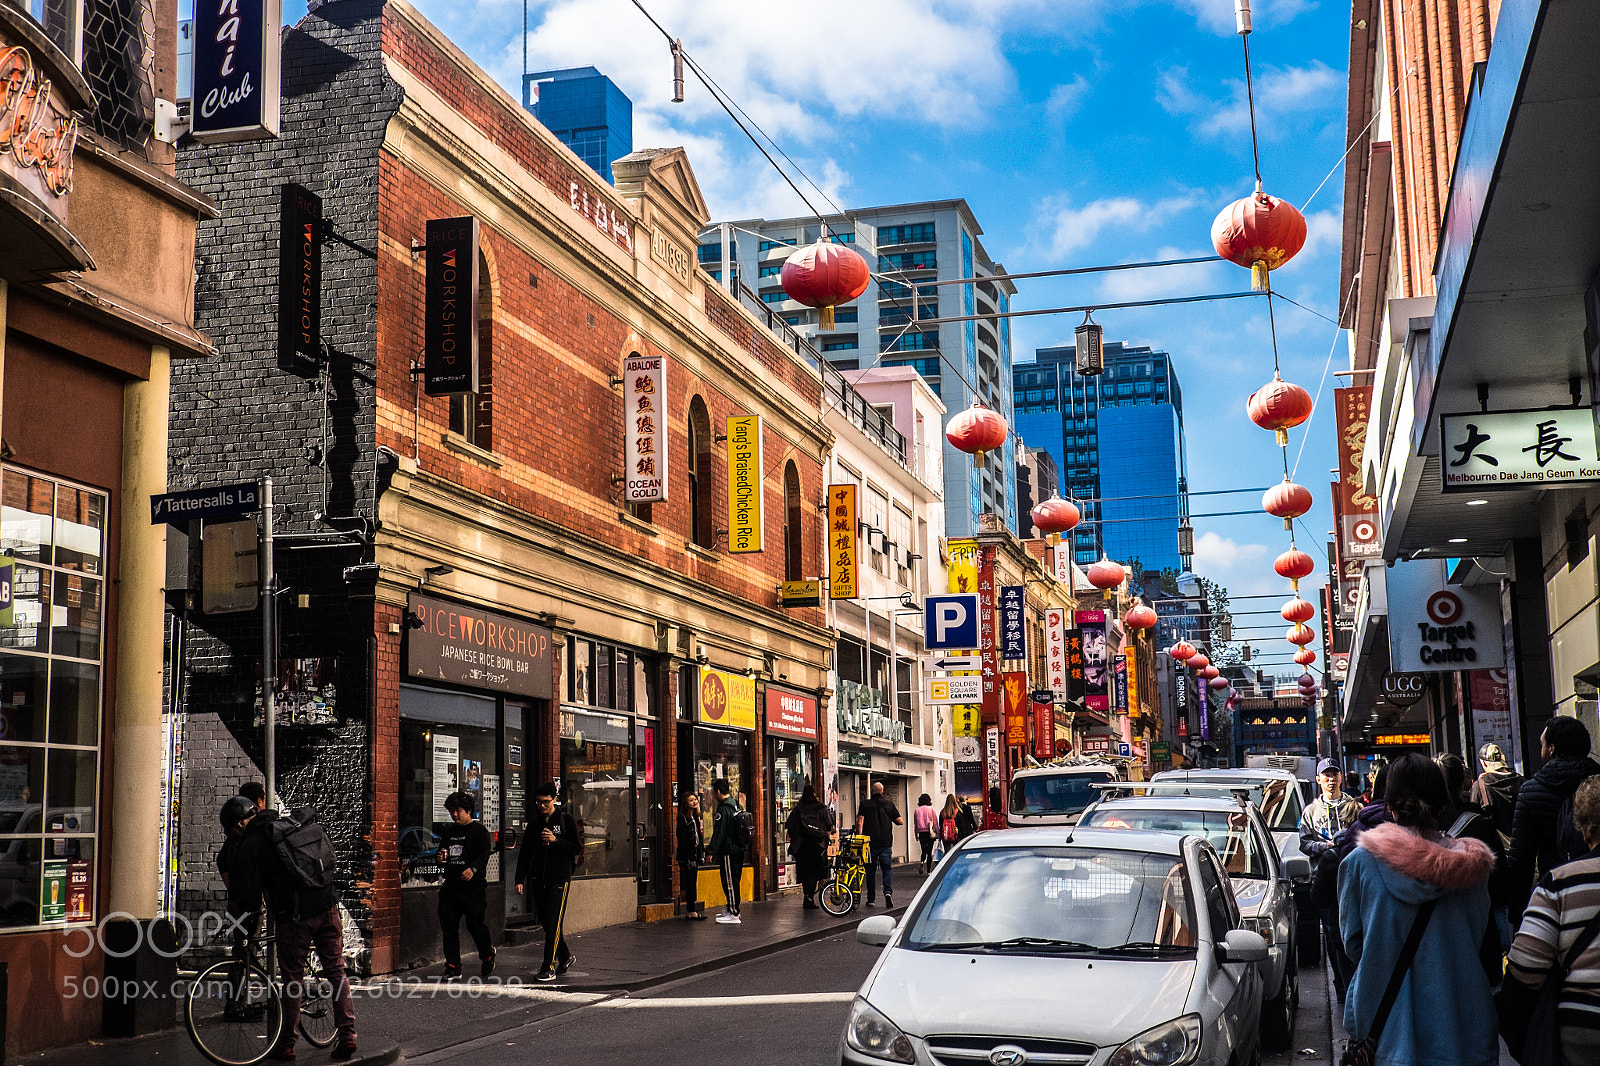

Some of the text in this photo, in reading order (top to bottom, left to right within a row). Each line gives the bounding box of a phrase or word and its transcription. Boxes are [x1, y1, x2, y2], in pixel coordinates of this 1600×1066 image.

[201, 72, 254, 118] Club
[298, 196, 318, 217] RICE
[432, 228, 467, 242] RICE
[302, 224, 312, 344] WORKSHOP
[442, 249, 457, 365] WORKSHOP
[627, 360, 660, 371] ABALONE
[732, 418, 751, 450] Yang's
[628, 479, 661, 489] OCEAN
[1447, 473, 1497, 483] Melbourne
[1500, 472, 1518, 481] Dae
[1520, 471, 1544, 480] Jang
[1546, 469, 1575, 478] Geum
[164, 489, 255, 512] Tattersalls La
[632, 489, 658, 499] GOLD
[737, 528, 753, 548] Rice
[834, 489, 852, 584] 中國城禮品店
[1058, 551, 1067, 585] EAS
[935, 601, 967, 643] P
[1418, 620, 1476, 644] Target
[441, 644, 529, 674] JAPANESE RICE BOWL BAR
[1419, 645, 1477, 665] Centre
[1385, 676, 1422, 692] UGG
[1121, 745, 1128, 754] P
